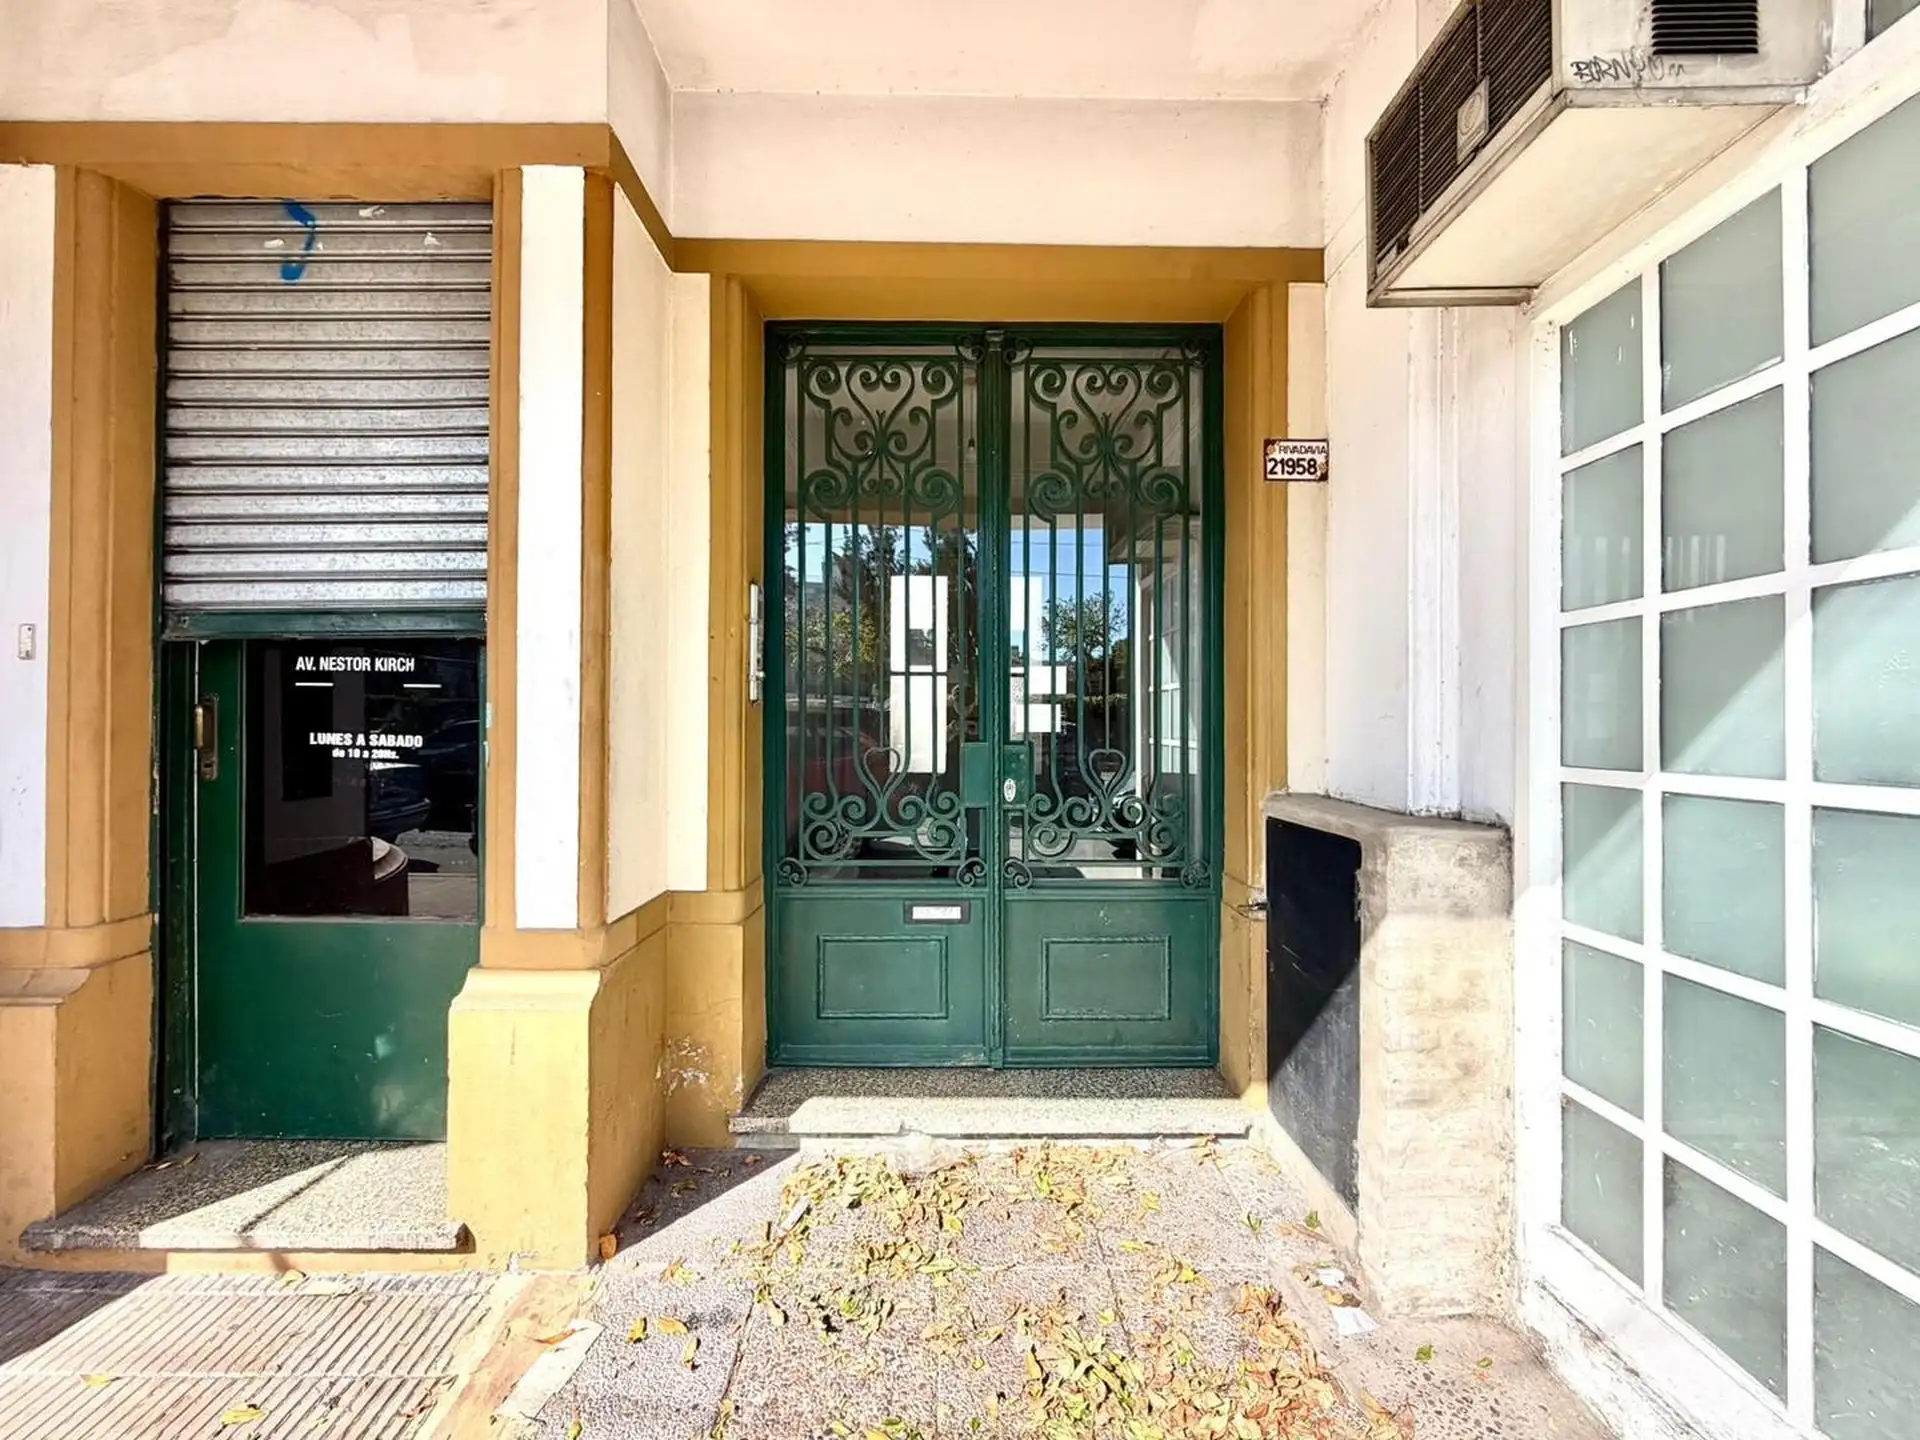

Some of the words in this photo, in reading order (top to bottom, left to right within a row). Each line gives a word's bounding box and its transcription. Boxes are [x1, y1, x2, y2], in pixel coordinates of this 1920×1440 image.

[1278, 445, 1327, 455] RIVADAVIA
[1267, 457, 1318, 476] 21958
[295, 656, 316, 672] AV.
[319, 657, 371, 672] NESTOR
[374, 657, 415, 673] KIRCH
[309, 732, 353, 746] LUNES
[356, 733, 366, 747] A
[369, 733, 423, 748] SABADO
[347, 748, 361, 759] 10
[362, 750, 370, 759] a
